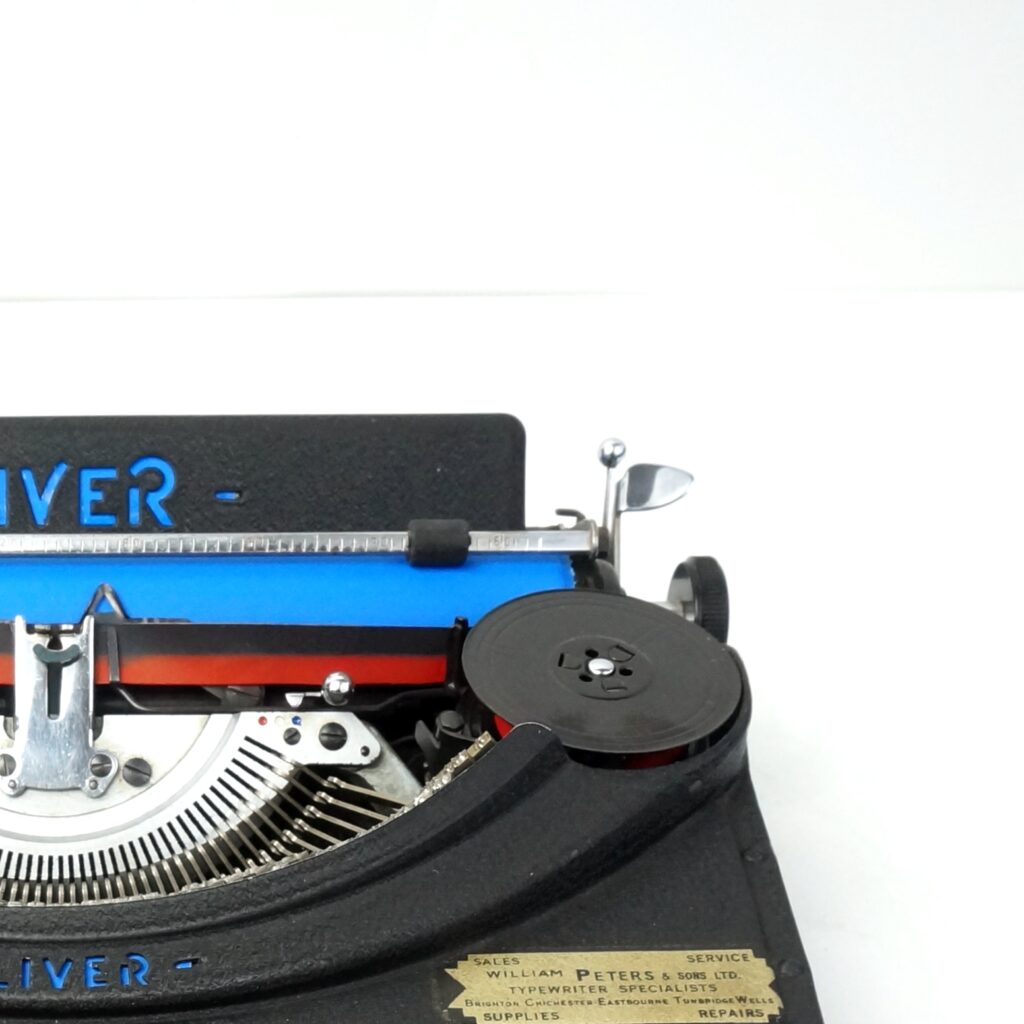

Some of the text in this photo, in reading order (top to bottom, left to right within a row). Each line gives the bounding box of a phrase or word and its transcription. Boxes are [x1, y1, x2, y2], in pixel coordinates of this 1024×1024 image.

[473, 957, 521, 966] SALES
[685, 953, 751, 963] SERVICE
[486, 969, 742, 982] WILLIAM PETERS & SONS LTD.
[509, 984, 718, 995] TYPEWRITER SPECIALISTS
[483, 1012, 560, 1022] SUPPLIES
[698, 1009, 764, 1019] REPAIRS
